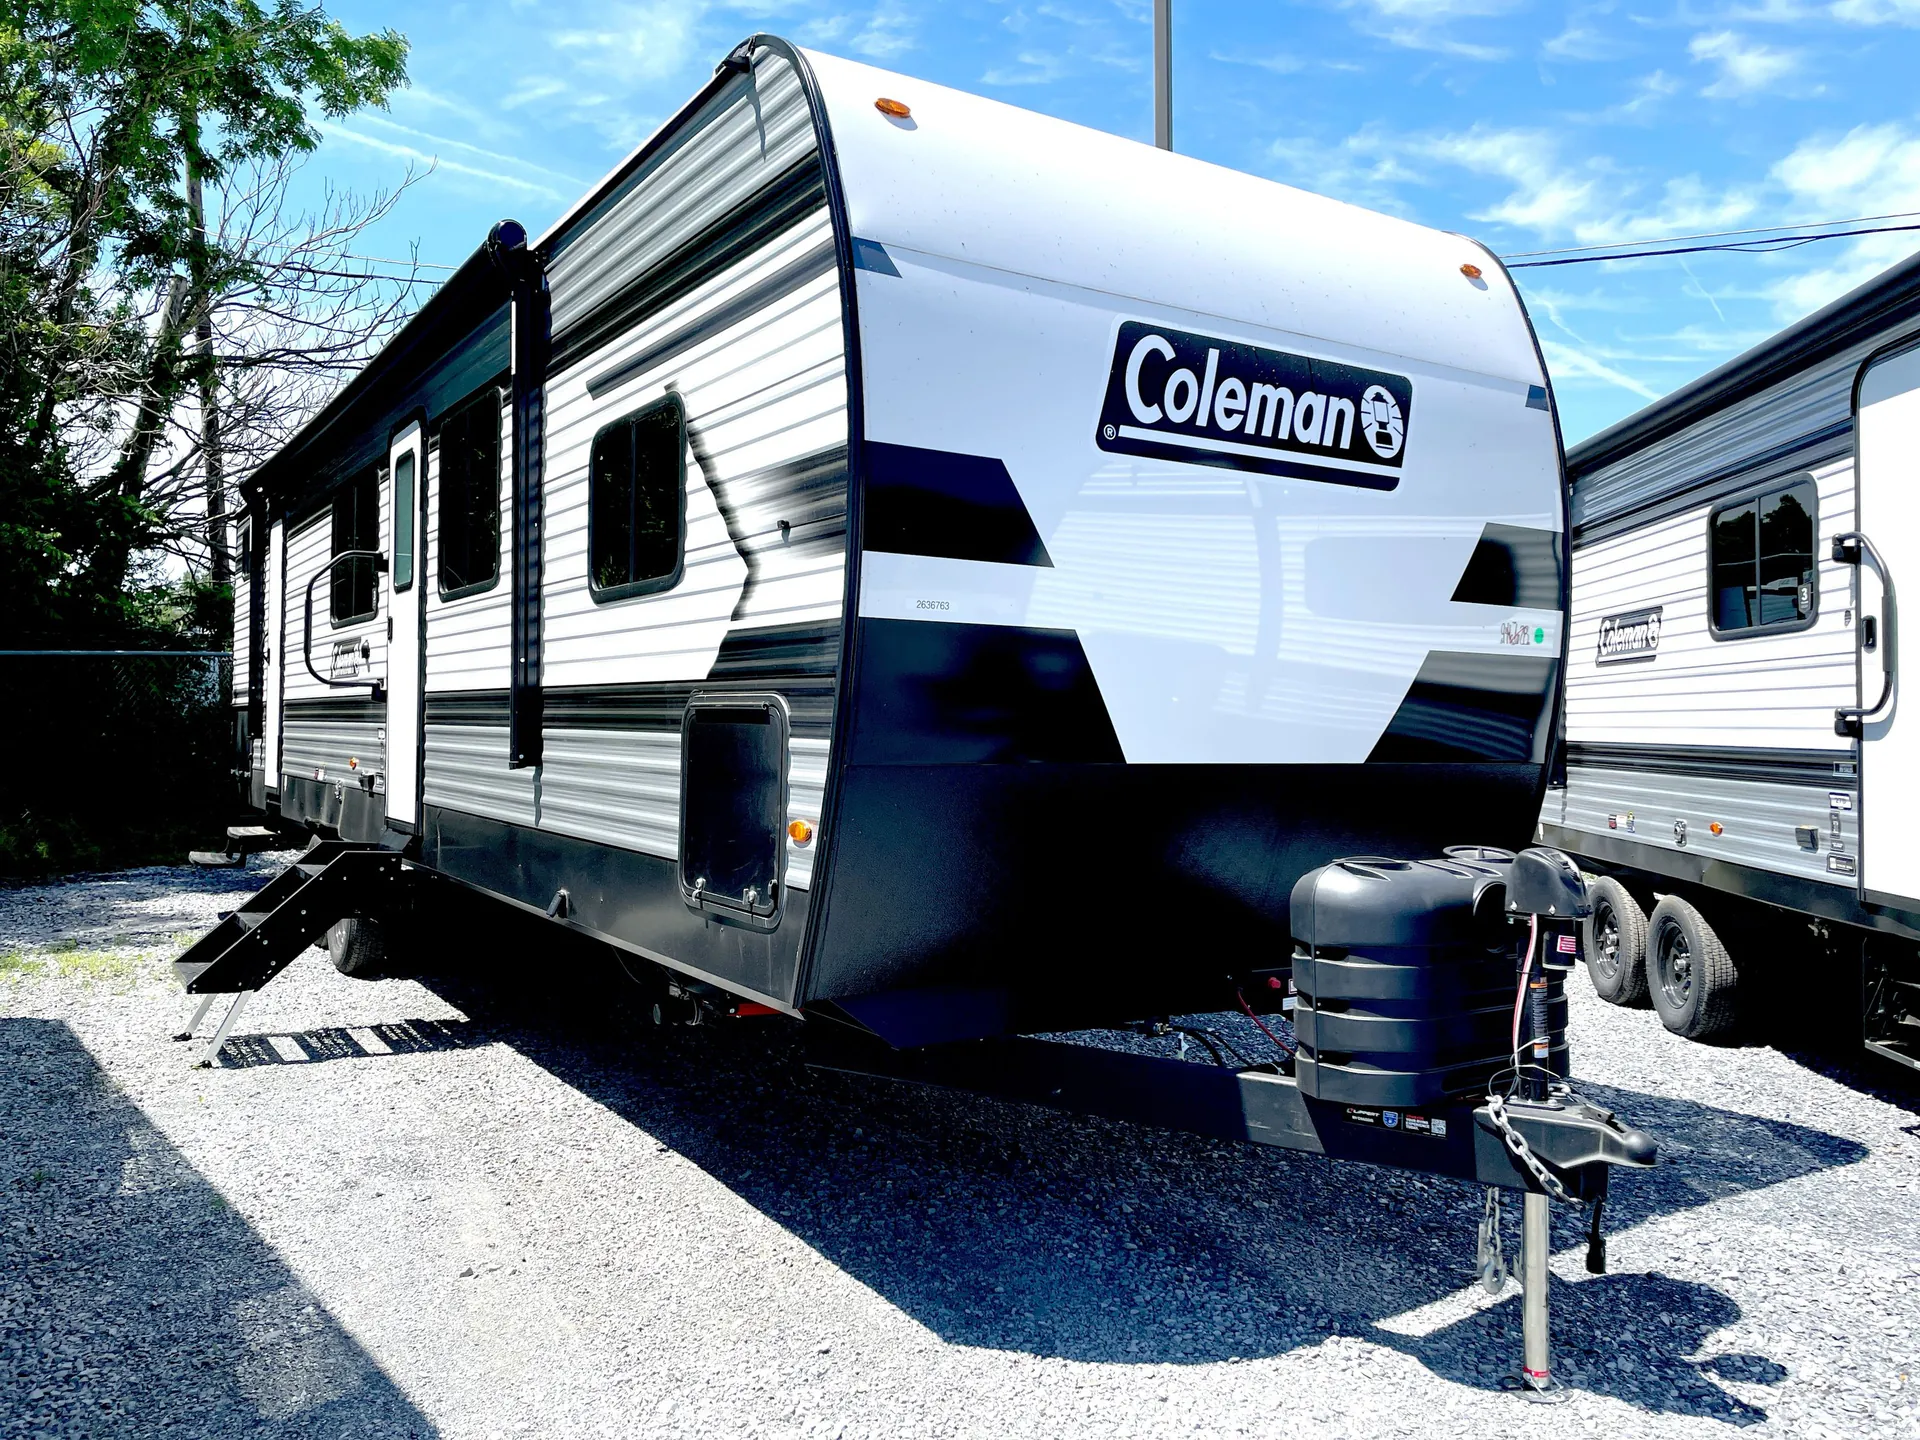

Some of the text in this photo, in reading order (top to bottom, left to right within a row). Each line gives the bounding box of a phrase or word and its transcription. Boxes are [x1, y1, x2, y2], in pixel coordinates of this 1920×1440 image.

[1124, 334, 1356, 450] Coleman
[916, 599, 950, 611] 2636763
[1801, 587, 1809, 601] 3
[1599, 618, 1649, 656] Coleman
